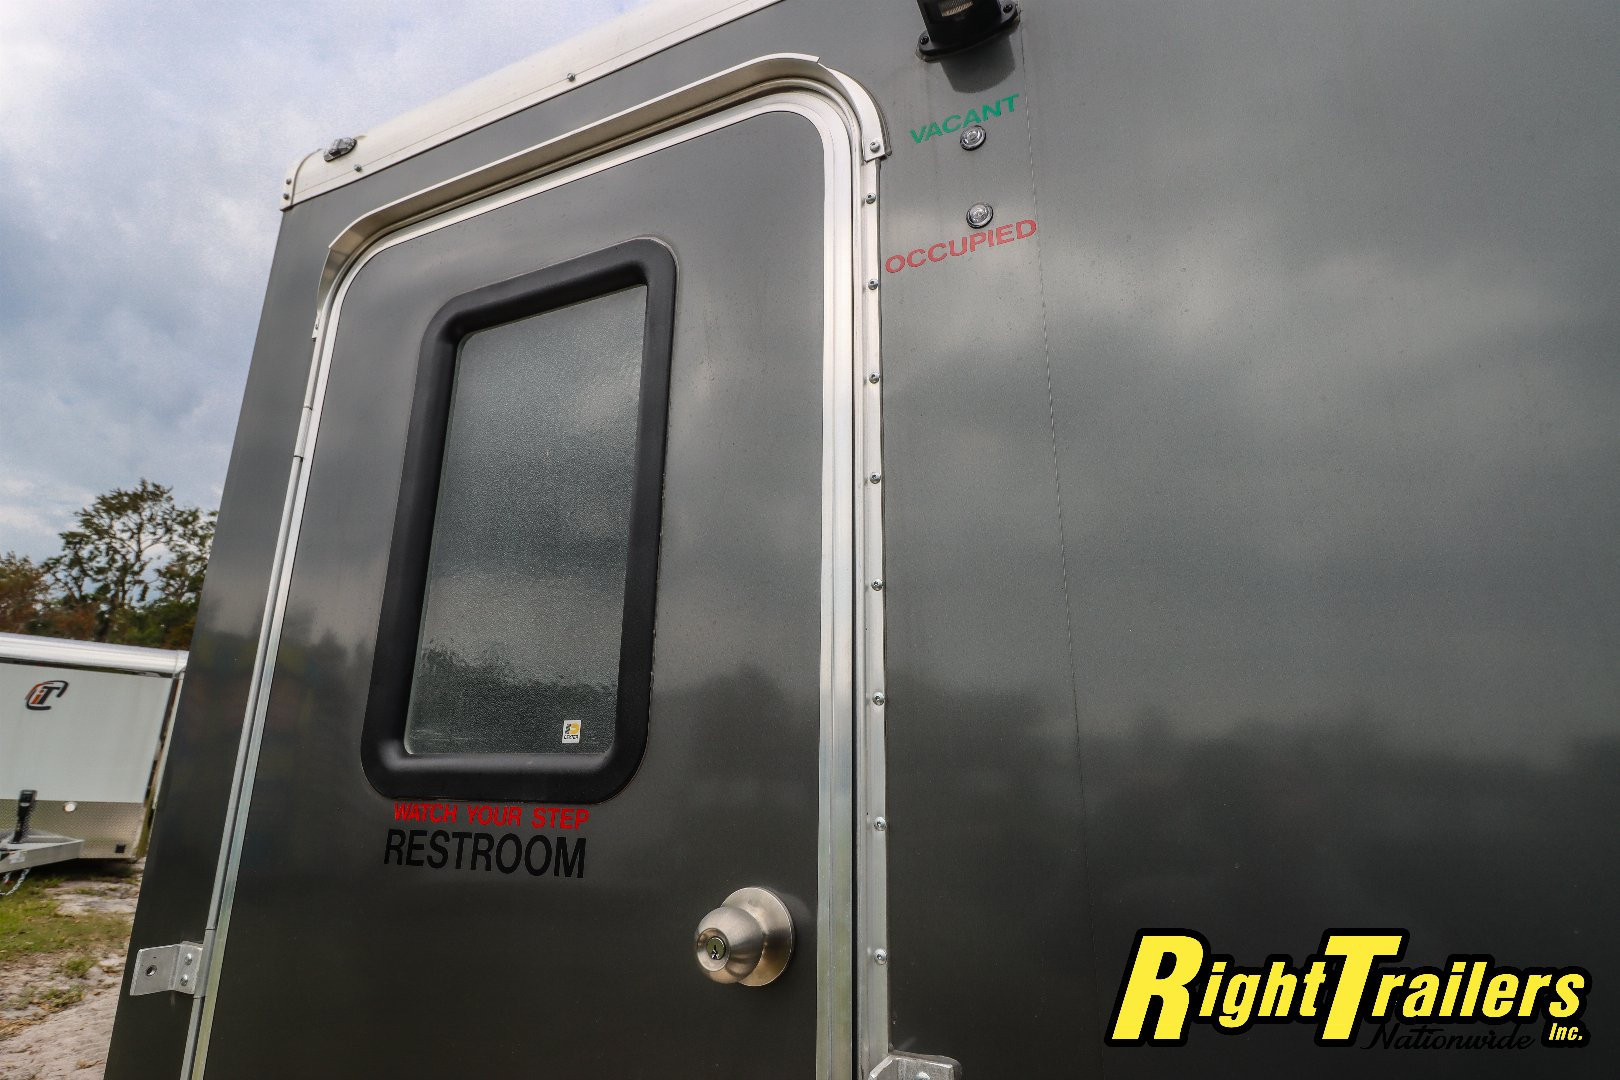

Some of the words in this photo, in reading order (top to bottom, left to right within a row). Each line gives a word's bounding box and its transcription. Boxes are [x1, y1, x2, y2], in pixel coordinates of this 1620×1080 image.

[909, 93, 1020, 144] VACANT
[885, 219, 1037, 274] OCCUPIED
[394, 801, 458, 823] WATCH
[467, 804, 523, 827] YOUR
[531, 807, 590, 830] STEP
[384, 828, 587, 878] RESTROOM
